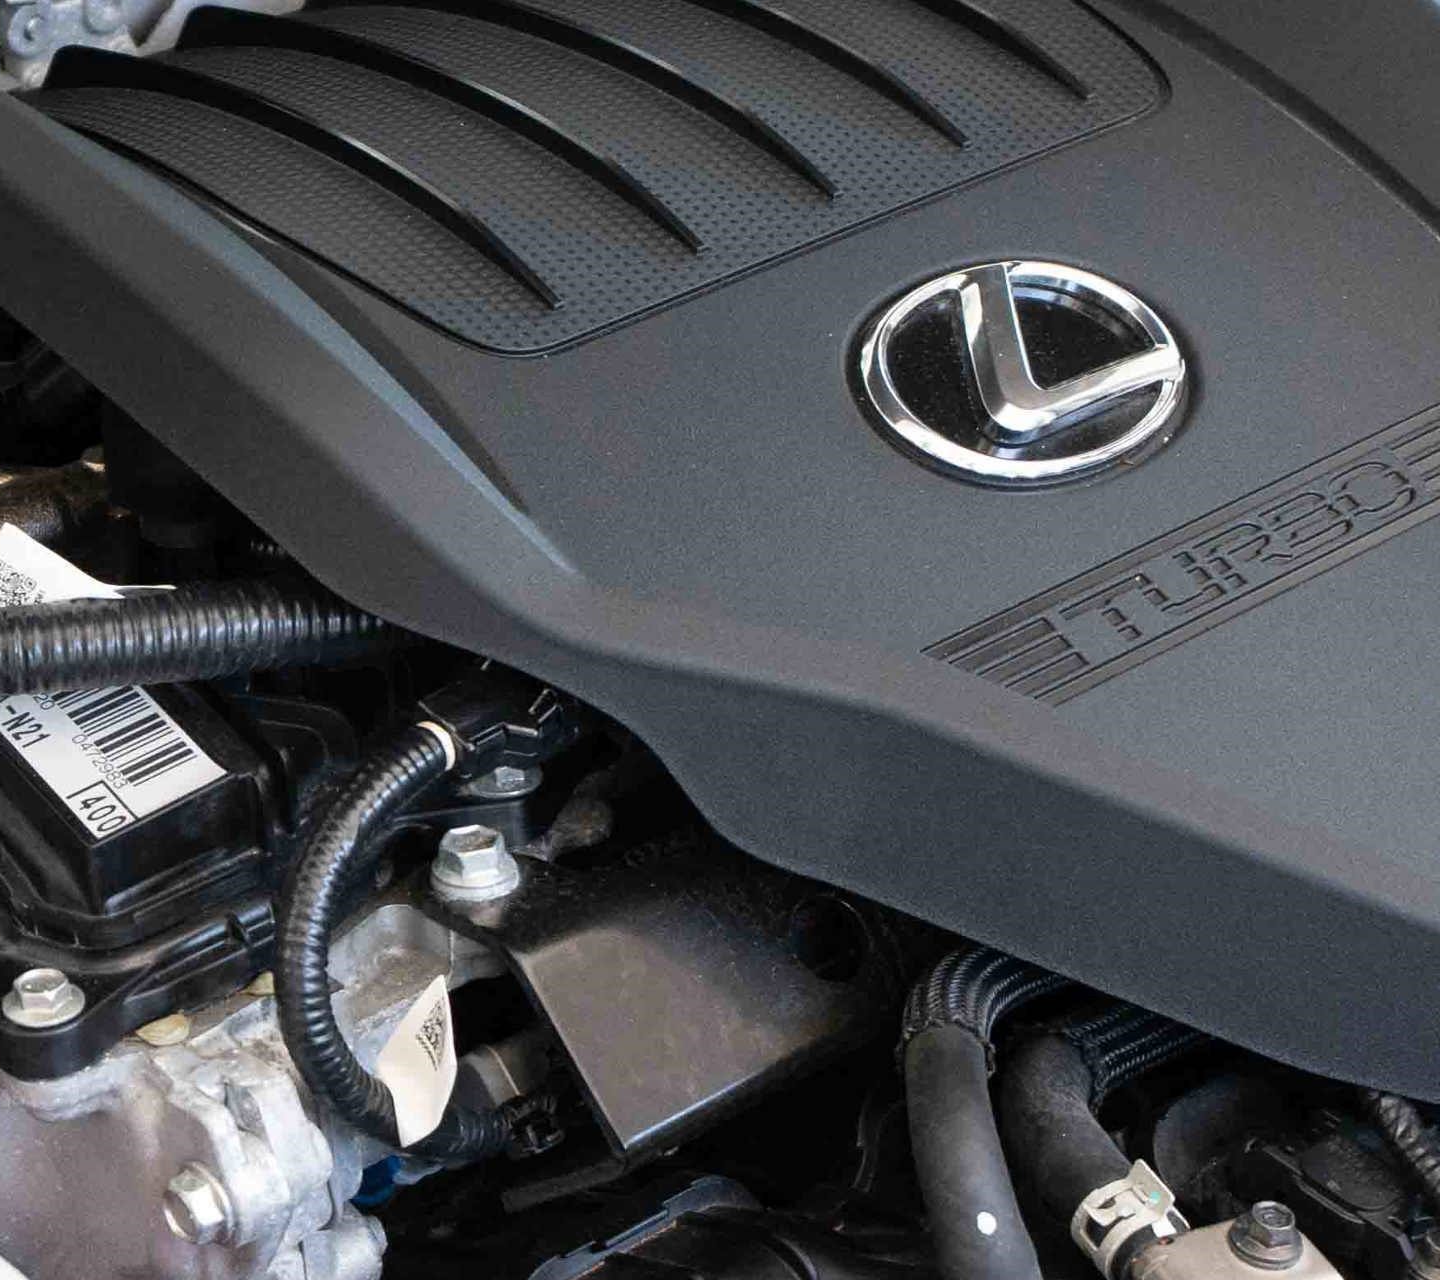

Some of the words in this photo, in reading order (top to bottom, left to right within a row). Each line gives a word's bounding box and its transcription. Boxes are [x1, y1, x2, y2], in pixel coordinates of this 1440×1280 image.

[1060, 460, 1418, 646] TURBO
[71, 735, 130, 790] 0472983
[78, 793, 129, 834] 400
